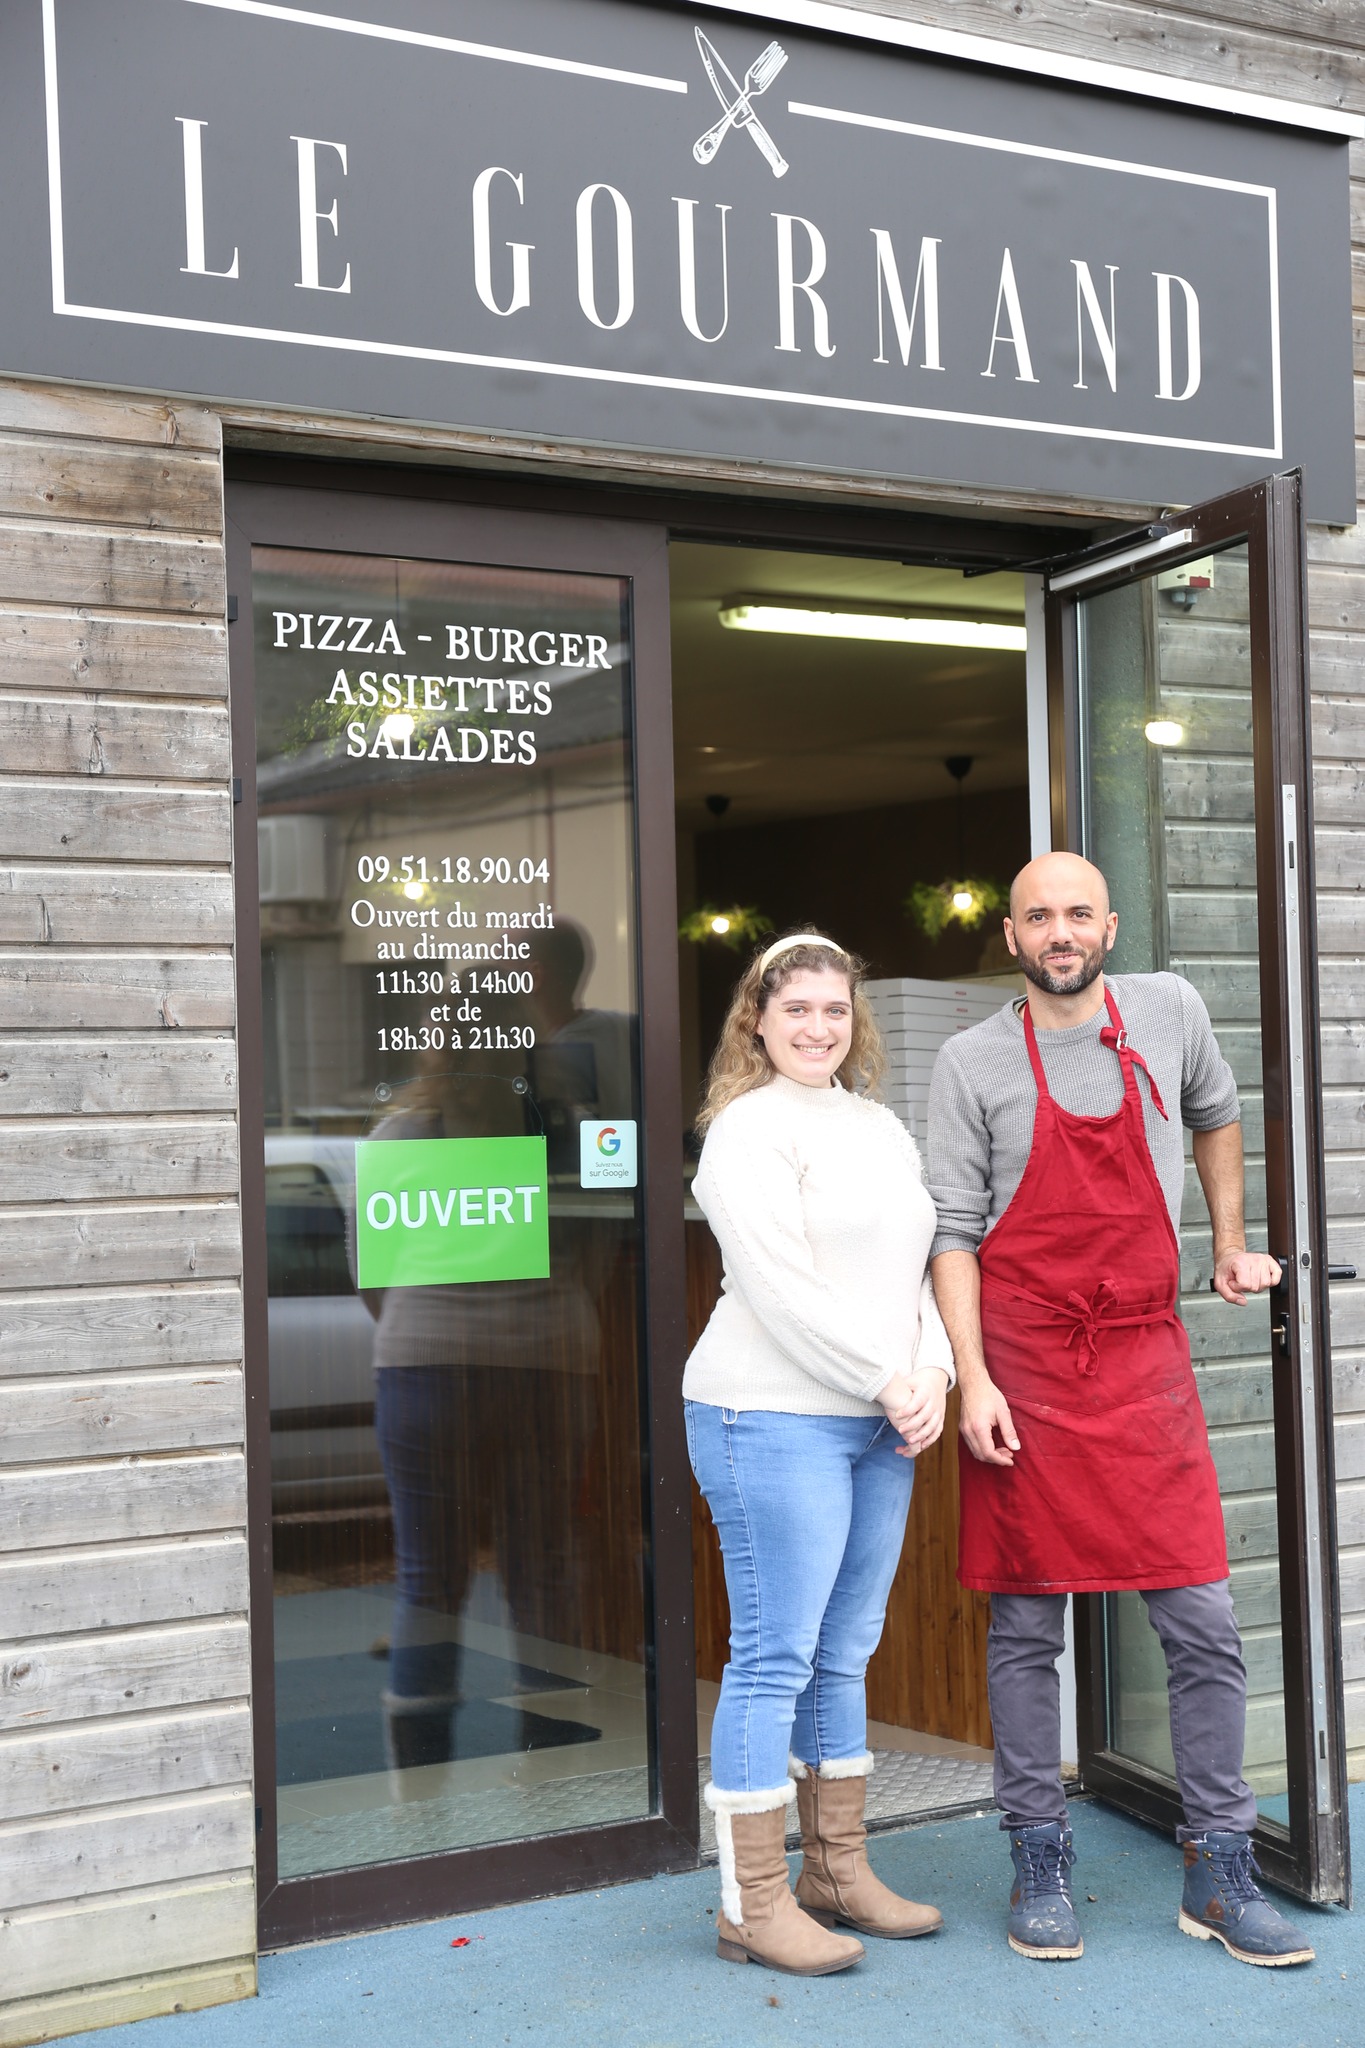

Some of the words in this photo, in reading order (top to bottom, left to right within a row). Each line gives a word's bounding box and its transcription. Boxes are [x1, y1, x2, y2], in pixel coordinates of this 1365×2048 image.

[175, 116, 352, 294] LE
[471, 166, 1202, 402] GOURMAND
[272, 611, 406, 656] PIZZA
[445, 624, 612, 669] BURGER
[325, 668, 552, 715] ASSIETTES
[347, 721, 537, 765] SALADES
[358, 855, 550, 884] 09.51.18.90.04
[351, 899, 440, 928] Ouvert
[447, 902, 478, 928] du
[485, 903, 555, 929] mardi
[376, 941, 406, 960] au
[413, 933, 531, 960] dimanche
[376, 970, 444, 994] 11h30
[450, 973, 462, 994] à
[468, 971, 534, 994] 14h00
[430, 1004, 450, 1021] et
[456, 998, 482, 1021] de
[377, 1027, 445, 1051] 18h30
[451, 1029, 463, 1050] à
[468, 1026, 536, 1050] 21h30
[602, 1169, 629, 1178] Google
[366, 1185, 540, 1230] OUVERT
